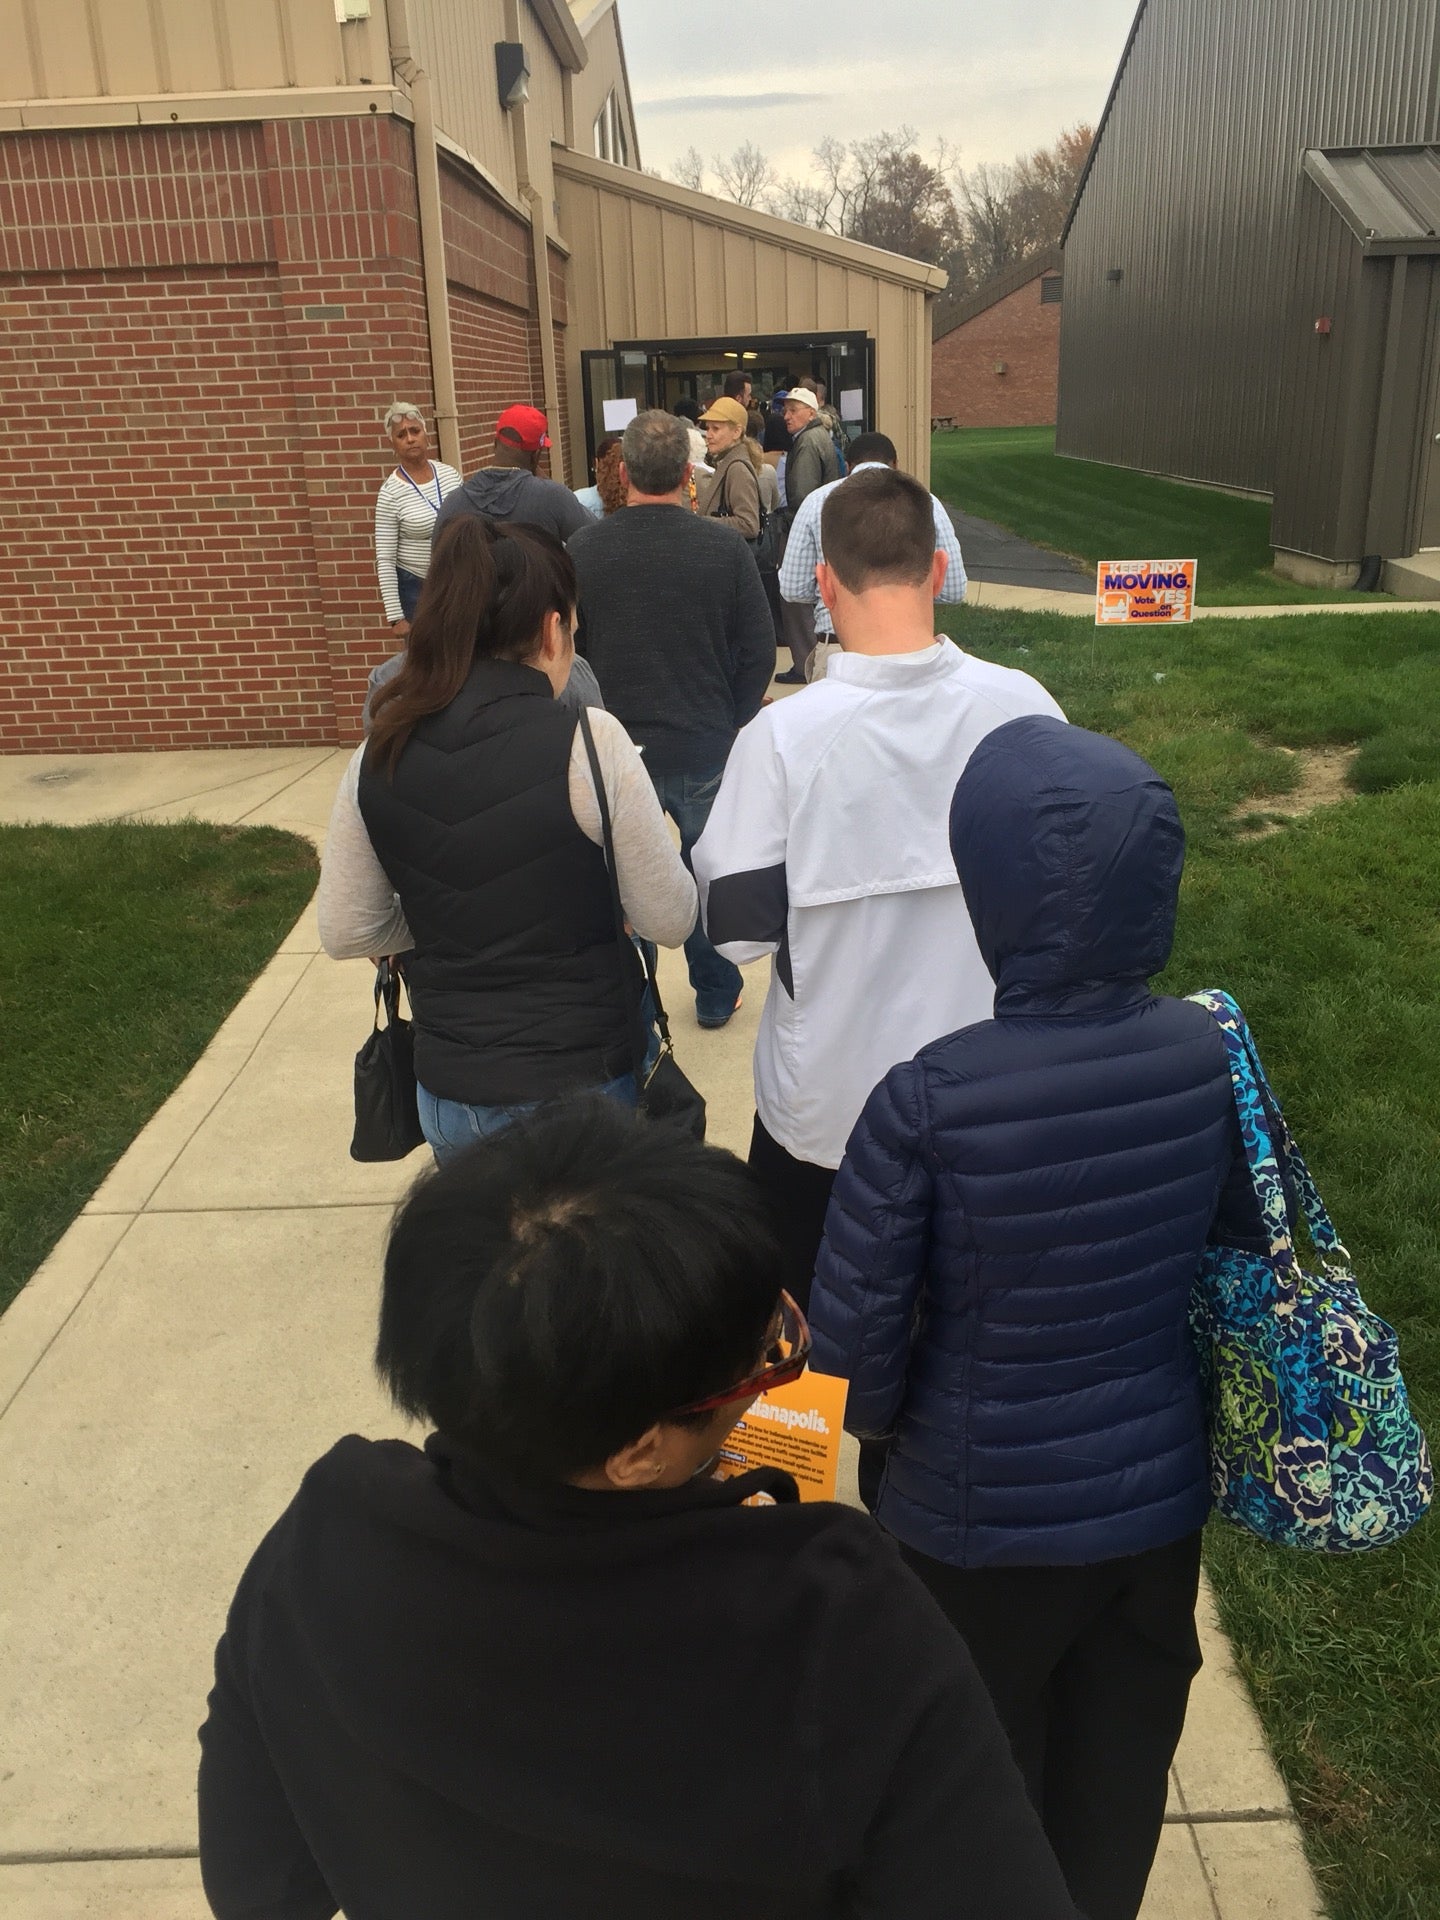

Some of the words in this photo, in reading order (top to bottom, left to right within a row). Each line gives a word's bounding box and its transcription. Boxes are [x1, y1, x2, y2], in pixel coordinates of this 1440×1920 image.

[1108, 563, 1148, 574] KEEP
[1149, 562, 1187, 573] INDY
[1104, 573, 1191, 589] MOVING.
[1134, 596, 1156, 604] Vote
[1152, 589, 1187, 603] YES
[1131, 609, 1171, 618] Question
[1171, 604, 1187, 620] 2
[746, 1396, 830, 1434] dianapolis.
